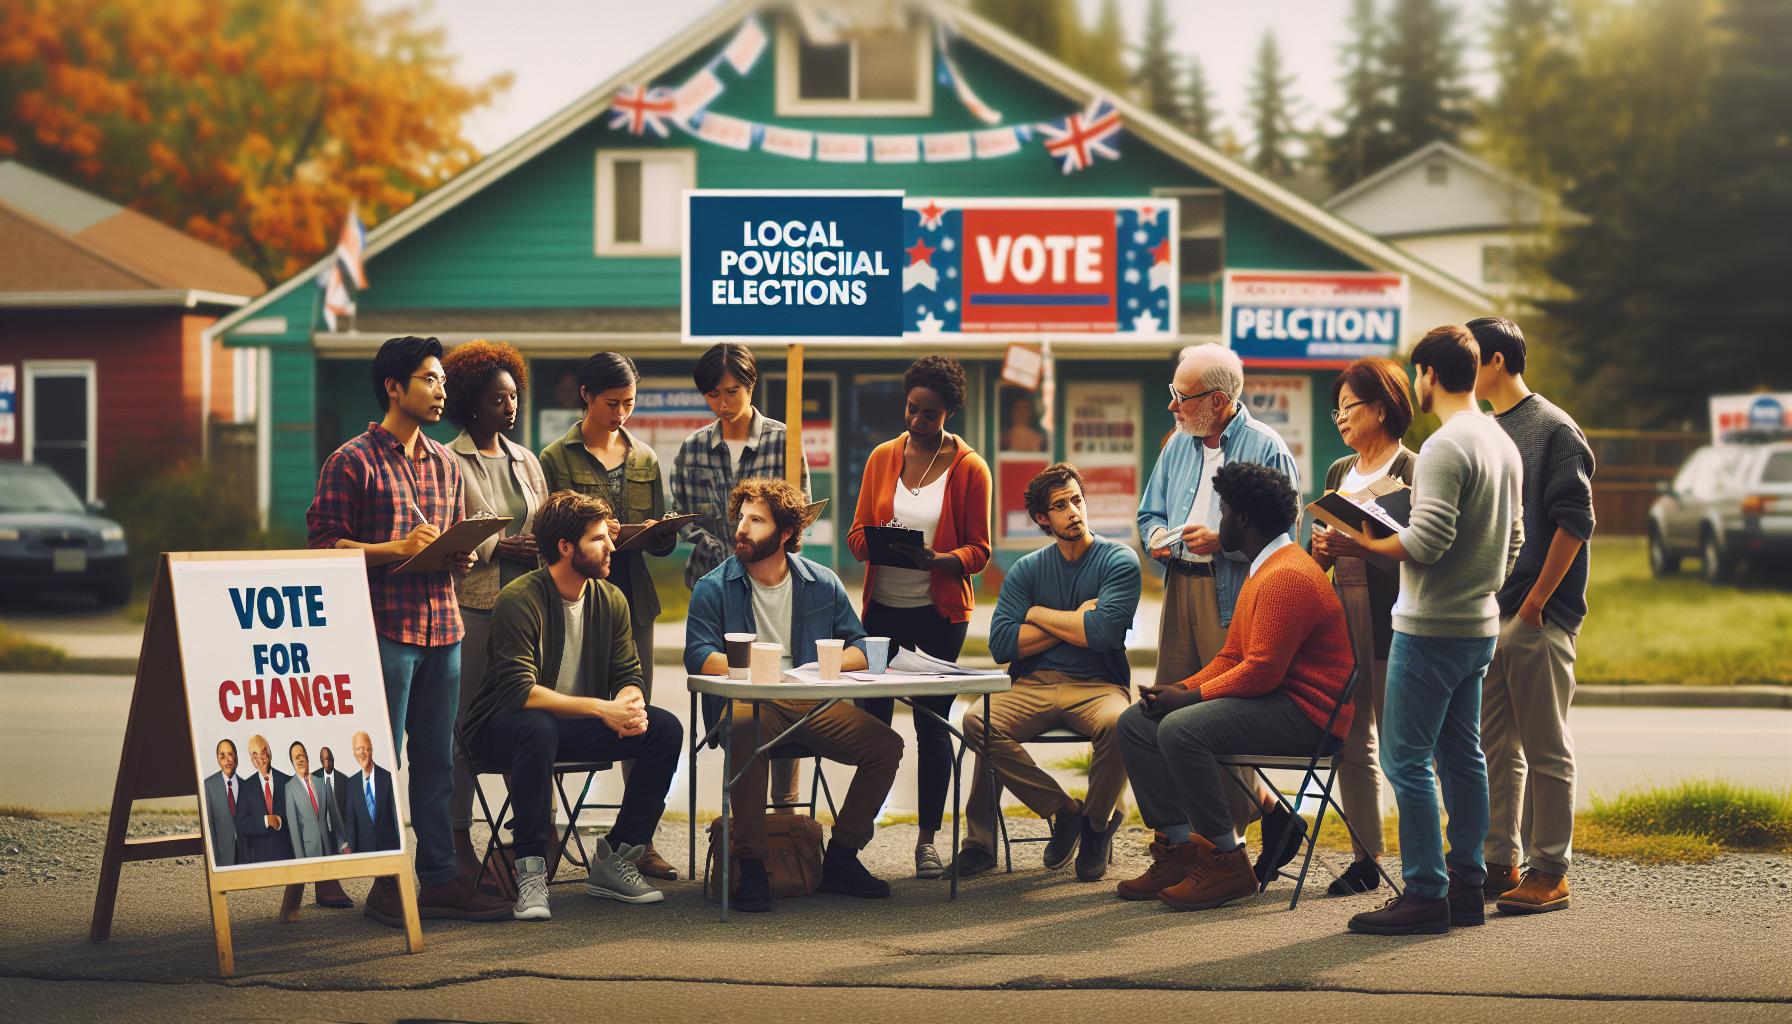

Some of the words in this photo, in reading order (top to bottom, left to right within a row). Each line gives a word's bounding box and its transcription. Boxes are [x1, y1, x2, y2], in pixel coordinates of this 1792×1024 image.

[743, 220, 845, 248] LOCAL
[976, 235, 1104, 285] VOTE
[712, 279, 868, 306] ELECTIONS
[1236, 308, 1395, 342] PELCTION
[228, 585, 327, 630] VOTE
[253, 643, 311, 676] FOR
[218, 674, 354, 723] CHANGE
